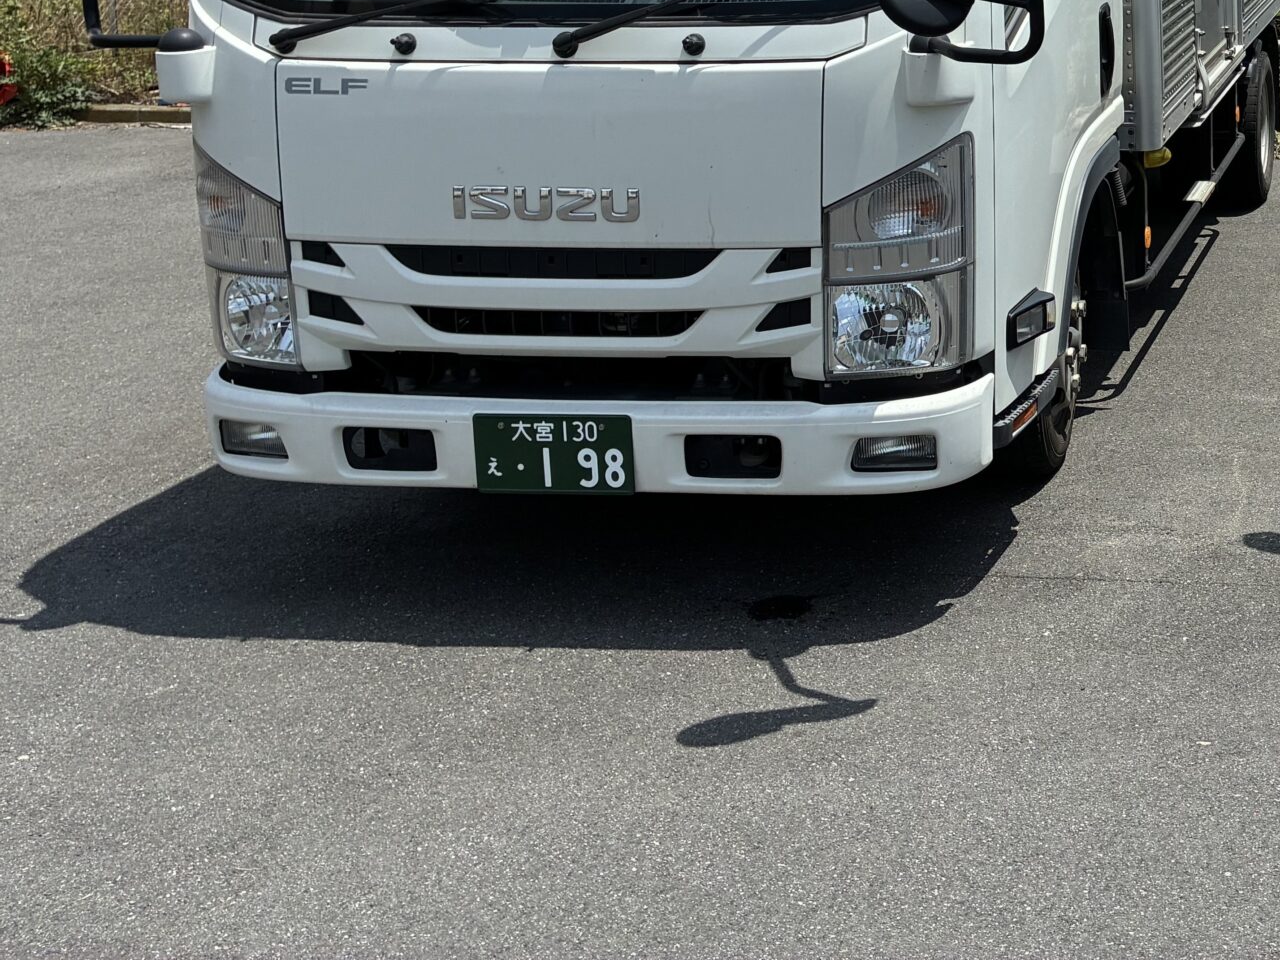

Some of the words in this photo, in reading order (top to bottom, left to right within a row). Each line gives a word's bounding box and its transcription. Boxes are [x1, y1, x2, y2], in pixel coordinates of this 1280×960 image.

[285, 77, 368, 95] ELF
[453, 185, 640, 222] ISUZU
[511, 420, 554, 441] 大宮
[562, 420, 597, 442] 130
[487, 457, 503, 476] え
